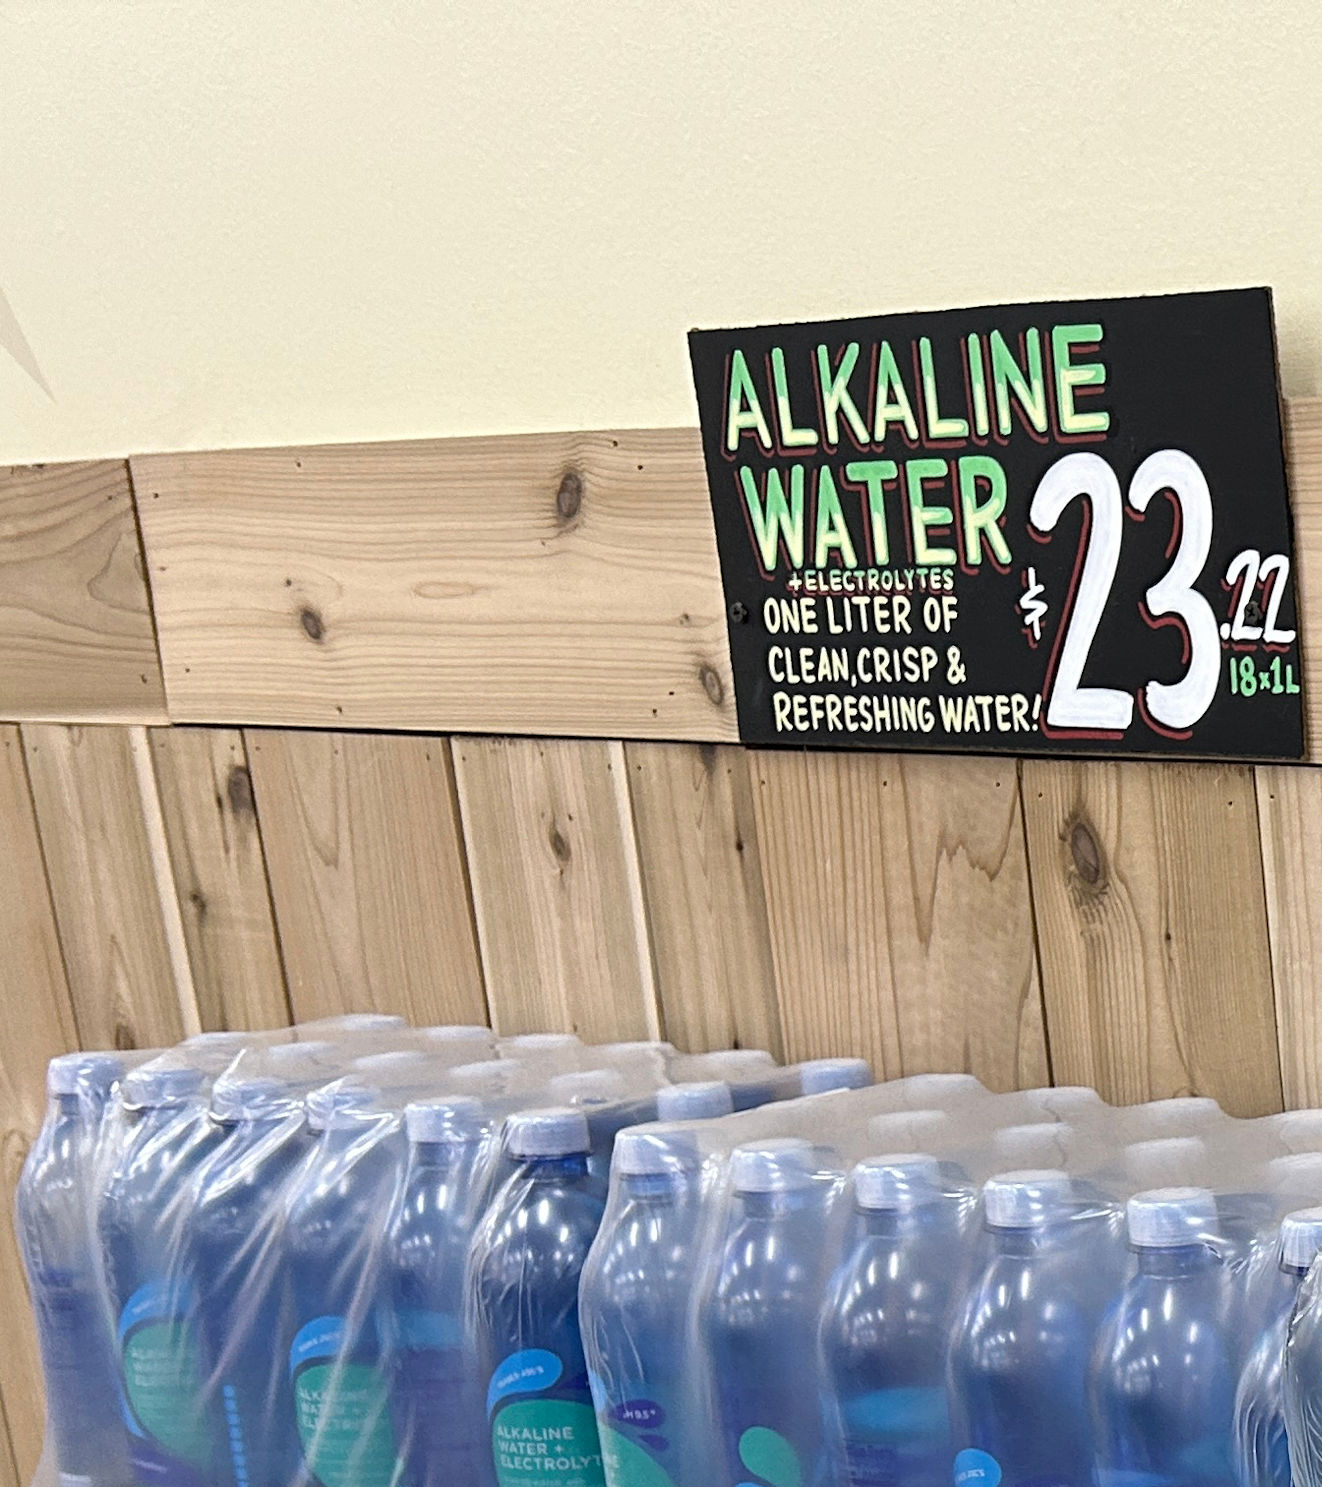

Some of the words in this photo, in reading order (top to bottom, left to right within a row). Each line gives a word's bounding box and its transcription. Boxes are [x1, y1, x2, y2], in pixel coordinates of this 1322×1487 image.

[723, 323, 1110, 456] ALKALINE
[736, 456, 1012, 577] WATER
[764, 596, 819, 635] ONE
[827, 596, 910, 635] LITER
[923, 595, 959, 633] OF
[946, 646, 967, 683] &
[774, 694, 935, 734] REFRESHING
[941, 693, 1042, 733] WATER!
